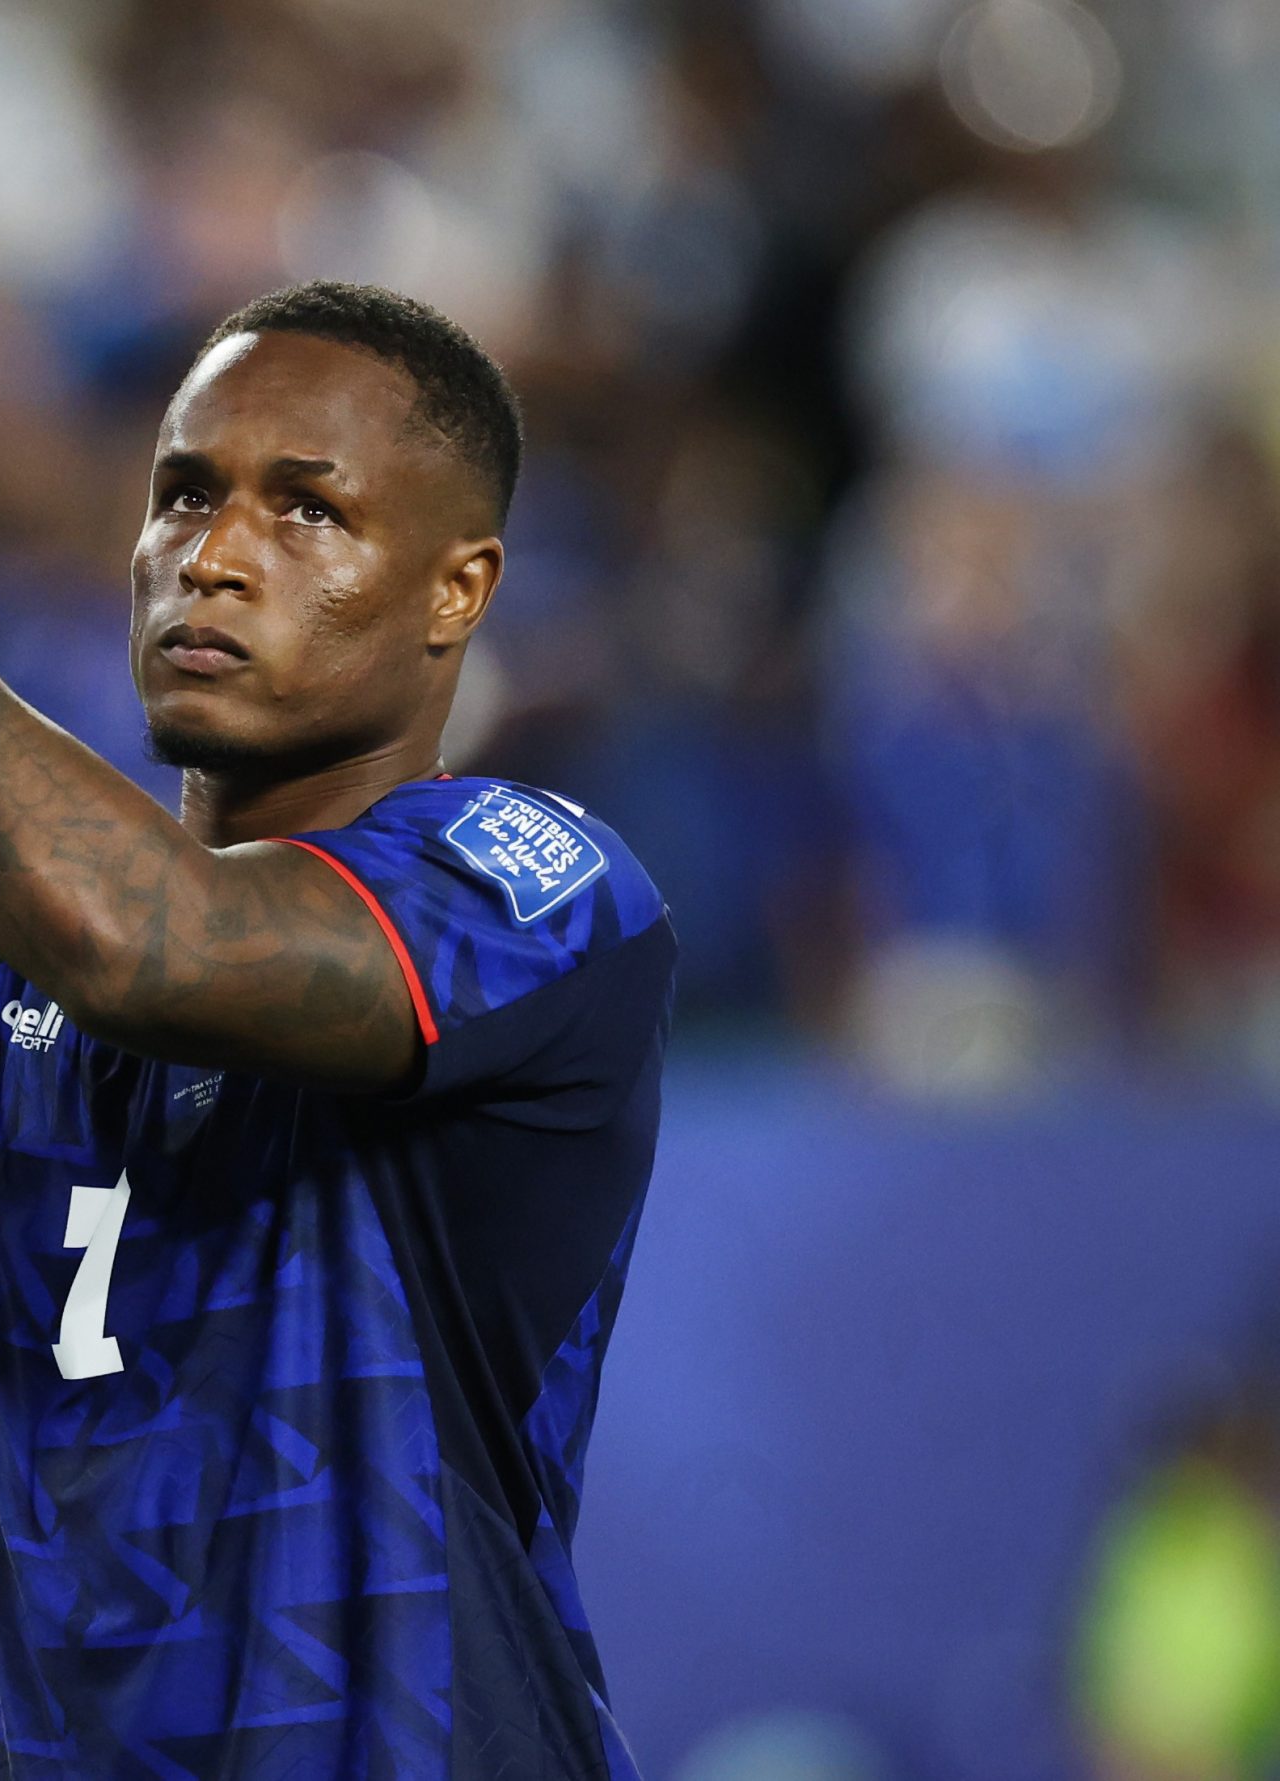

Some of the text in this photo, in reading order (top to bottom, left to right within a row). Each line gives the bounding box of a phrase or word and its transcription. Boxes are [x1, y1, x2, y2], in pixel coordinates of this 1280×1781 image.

[478, 816, 561, 893] the World
[490, 845, 521, 877] FIFA
[498, 805, 574, 873] UNITES
[10, 1028, 55, 1053] PORT
[51, 1166, 132, 1381] 7
